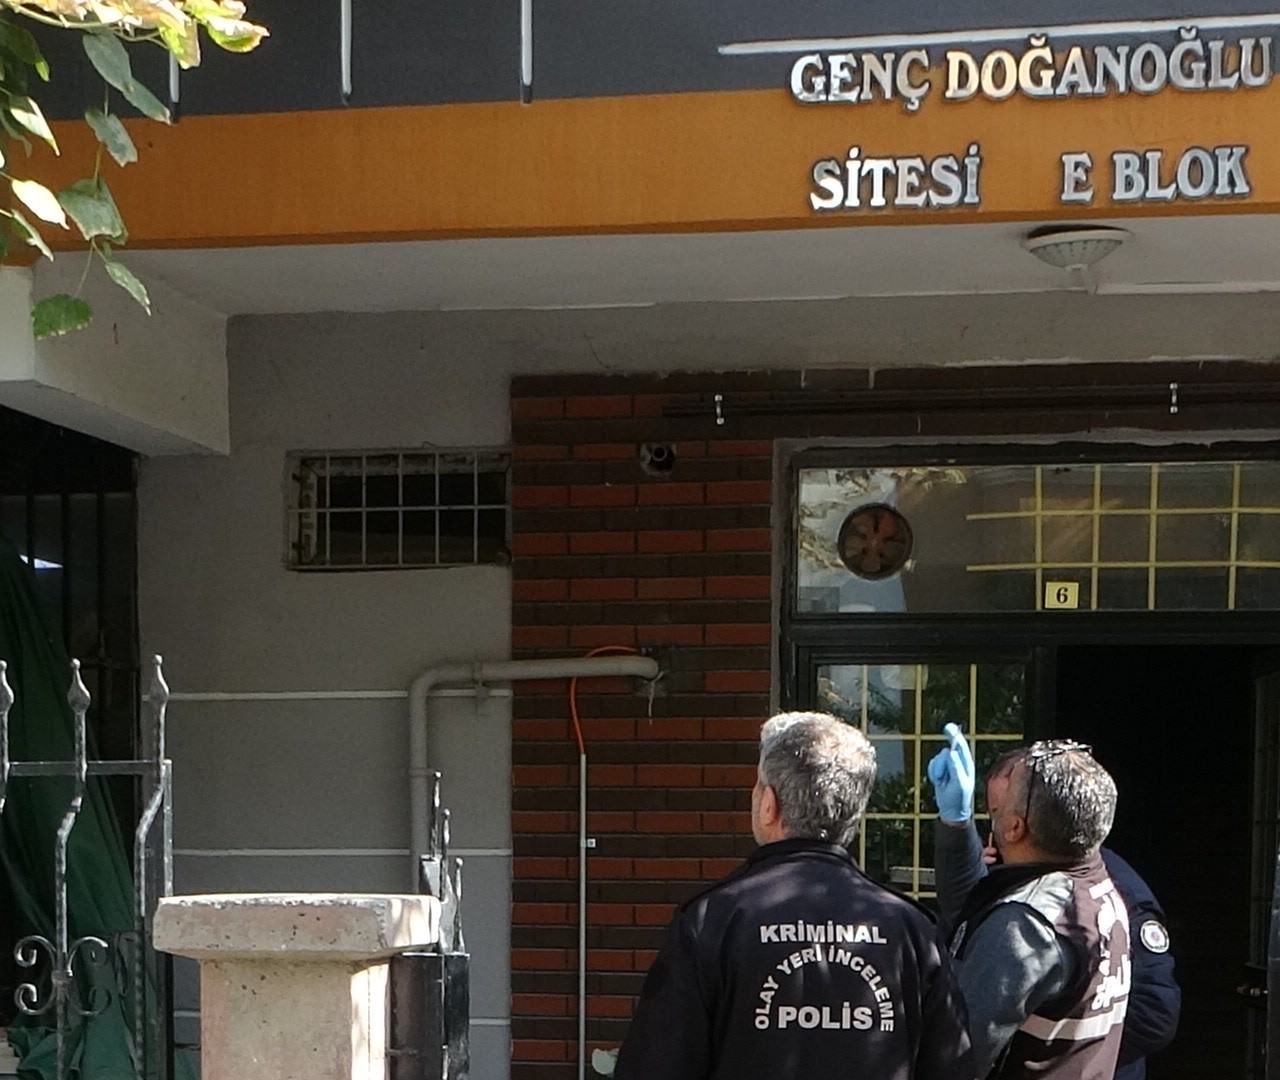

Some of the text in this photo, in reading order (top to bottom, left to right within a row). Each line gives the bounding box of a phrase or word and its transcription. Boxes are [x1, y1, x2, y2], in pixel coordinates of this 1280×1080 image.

[790, 27, 1276, 112] GENÇ DOĞANOĞLU
[809, 143, 1251, 211] SİTESİ E BLOK
[1056, 586, 1069, 604] 6
[760, 919, 887, 944] KRİMİNAL
[754, 944, 895, 1033] OLAY YERİ İNCELEME
[778, 1001, 873, 1030] POLİS
